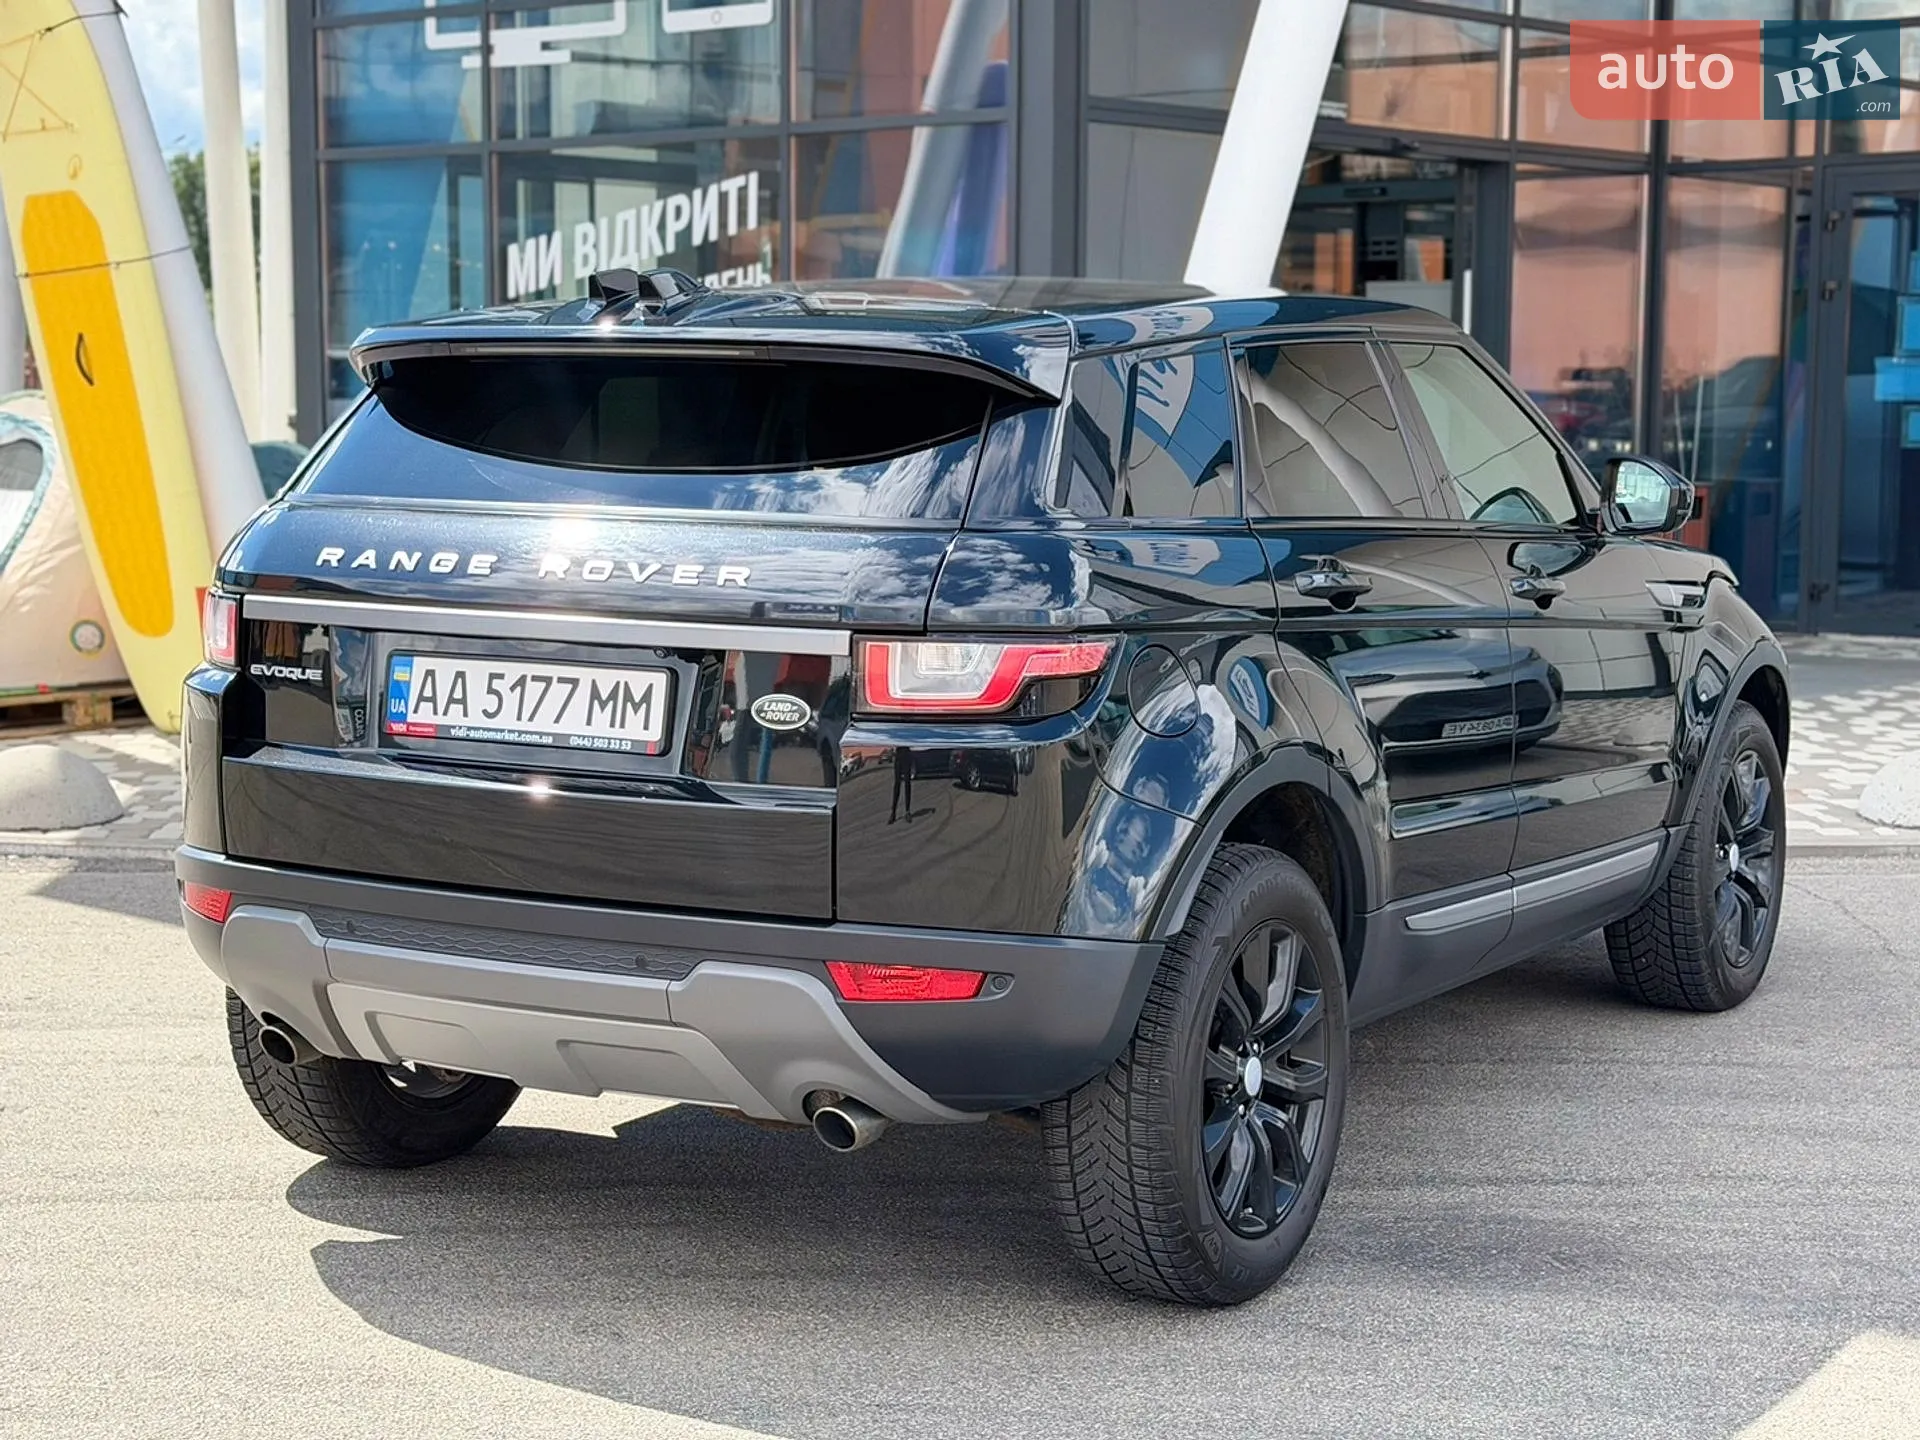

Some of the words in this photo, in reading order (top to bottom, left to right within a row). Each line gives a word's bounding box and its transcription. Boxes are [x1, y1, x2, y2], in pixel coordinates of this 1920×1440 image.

[506, 231, 563, 299] МИ
[574, 170, 760, 280] ВІДКРИТІ
[316, 546, 499, 577] RANGE
[538, 552, 752, 588] ROVER
[250, 663, 323, 681] EVOQUE
[390, 698, 407, 714] UA
[412, 667, 470, 720] AA
[482, 673, 580, 724] 5177
[587, 679, 655, 732] MM
[763, 701, 792, 712] LAND
[765, 710, 800, 722] ROVER
[450, 726, 553, 744] vidi-automarket.com.ua
[569, 736, 593, 747] (044)
[593, 737, 608, 749] 503
[609, 738, 620, 749] 33
